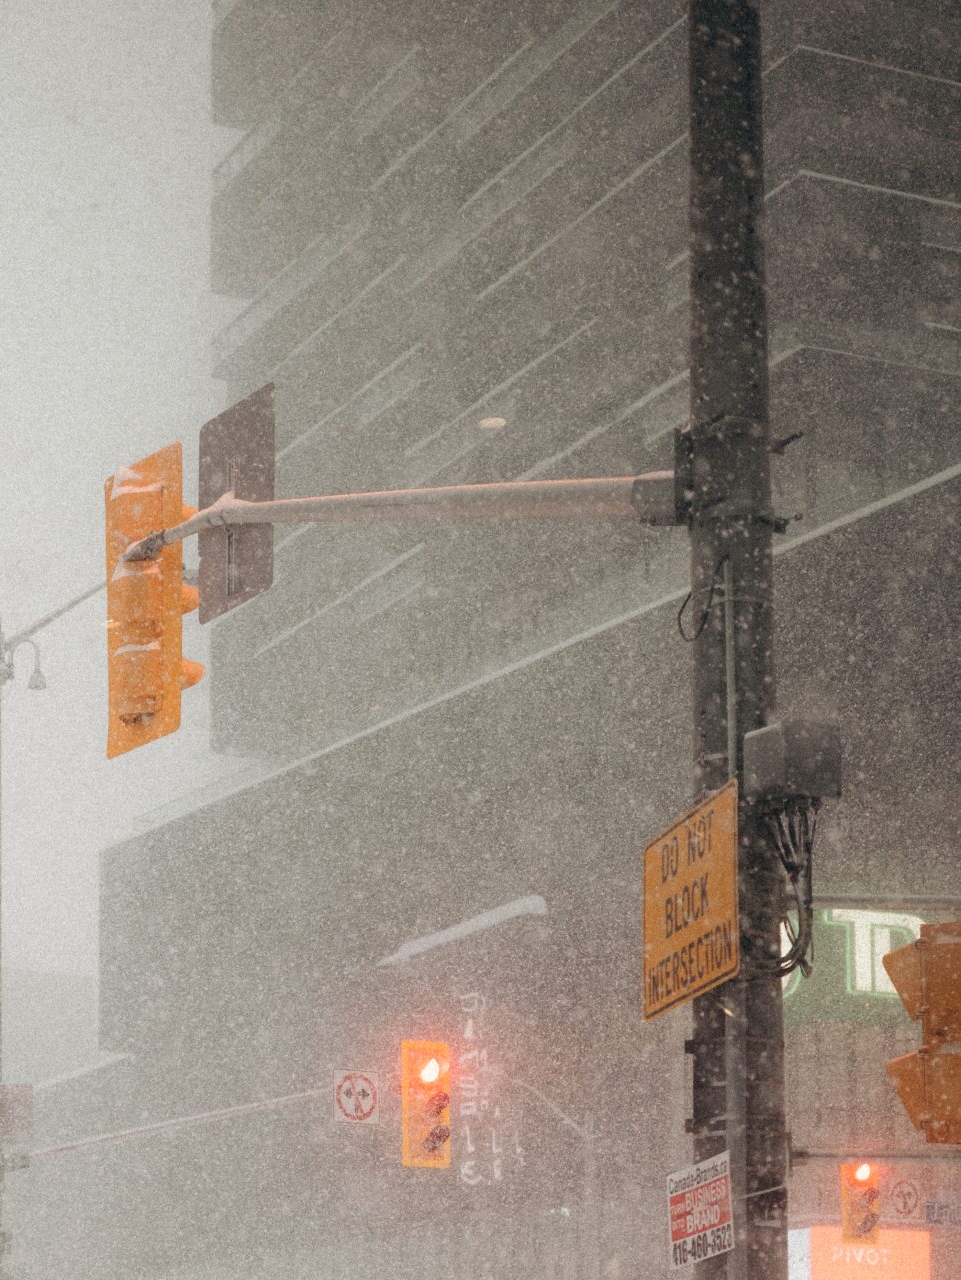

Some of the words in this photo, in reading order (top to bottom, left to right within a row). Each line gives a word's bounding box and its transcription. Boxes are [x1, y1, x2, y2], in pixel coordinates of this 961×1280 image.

[661, 836, 679, 884] DO
[687, 810, 714, 865] NOT
[665, 872, 709, 939] BLOCK
[648, 920, 733, 1007] INTERSECTION
[685, 1179, 726, 1211] BUSINESS
[686, 1204, 720, 1233] BRAND
[832, 1247, 891, 1265] PIVOT
